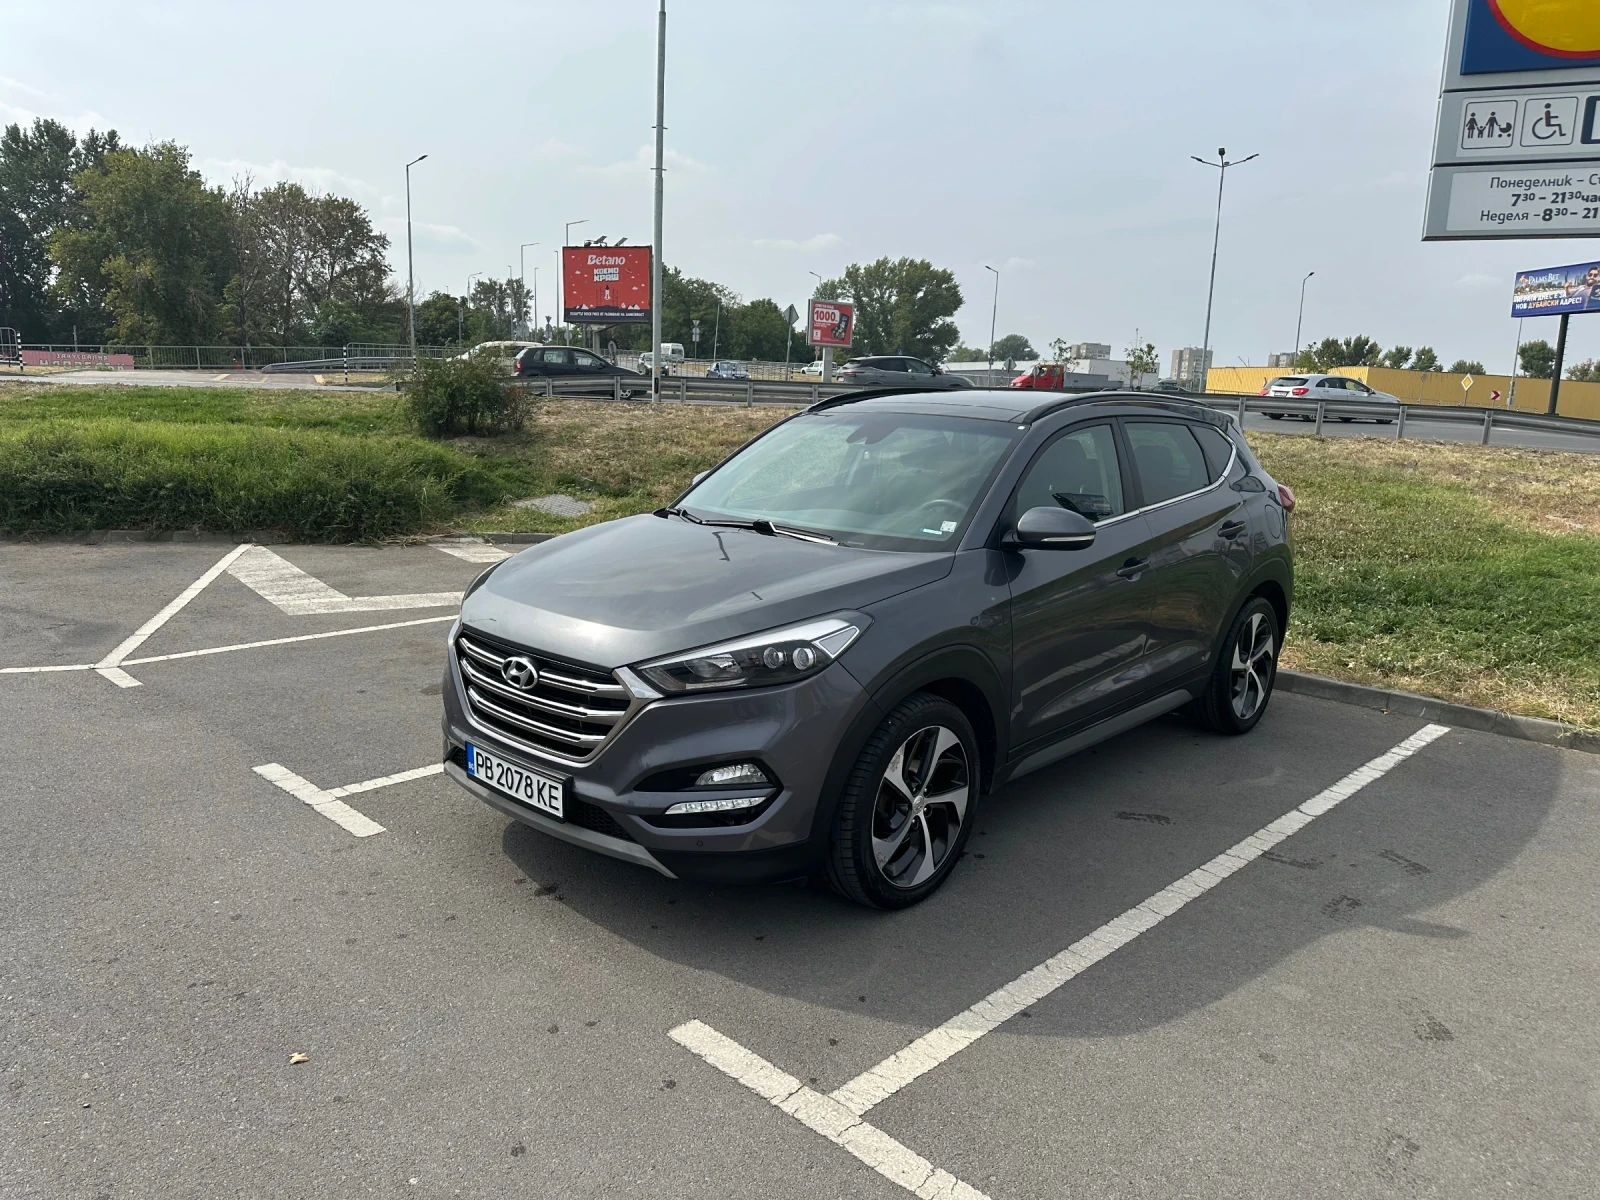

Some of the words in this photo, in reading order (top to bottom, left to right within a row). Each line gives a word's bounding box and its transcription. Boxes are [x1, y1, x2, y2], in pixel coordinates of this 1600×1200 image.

[1490, 175, 1572, 191] Понеделник
[1480, 210, 1529, 224] Неделя
[587, 254, 626, 265] Betano
[593, 274, 619, 282] КРАШ
[1528, 299, 1559, 309] ДУБАЙСКИ
[1560, 296, 1582, 306] АДРЕС!
[815, 310, 835, 321] 1000
[496, 762, 534, 799] 2078
